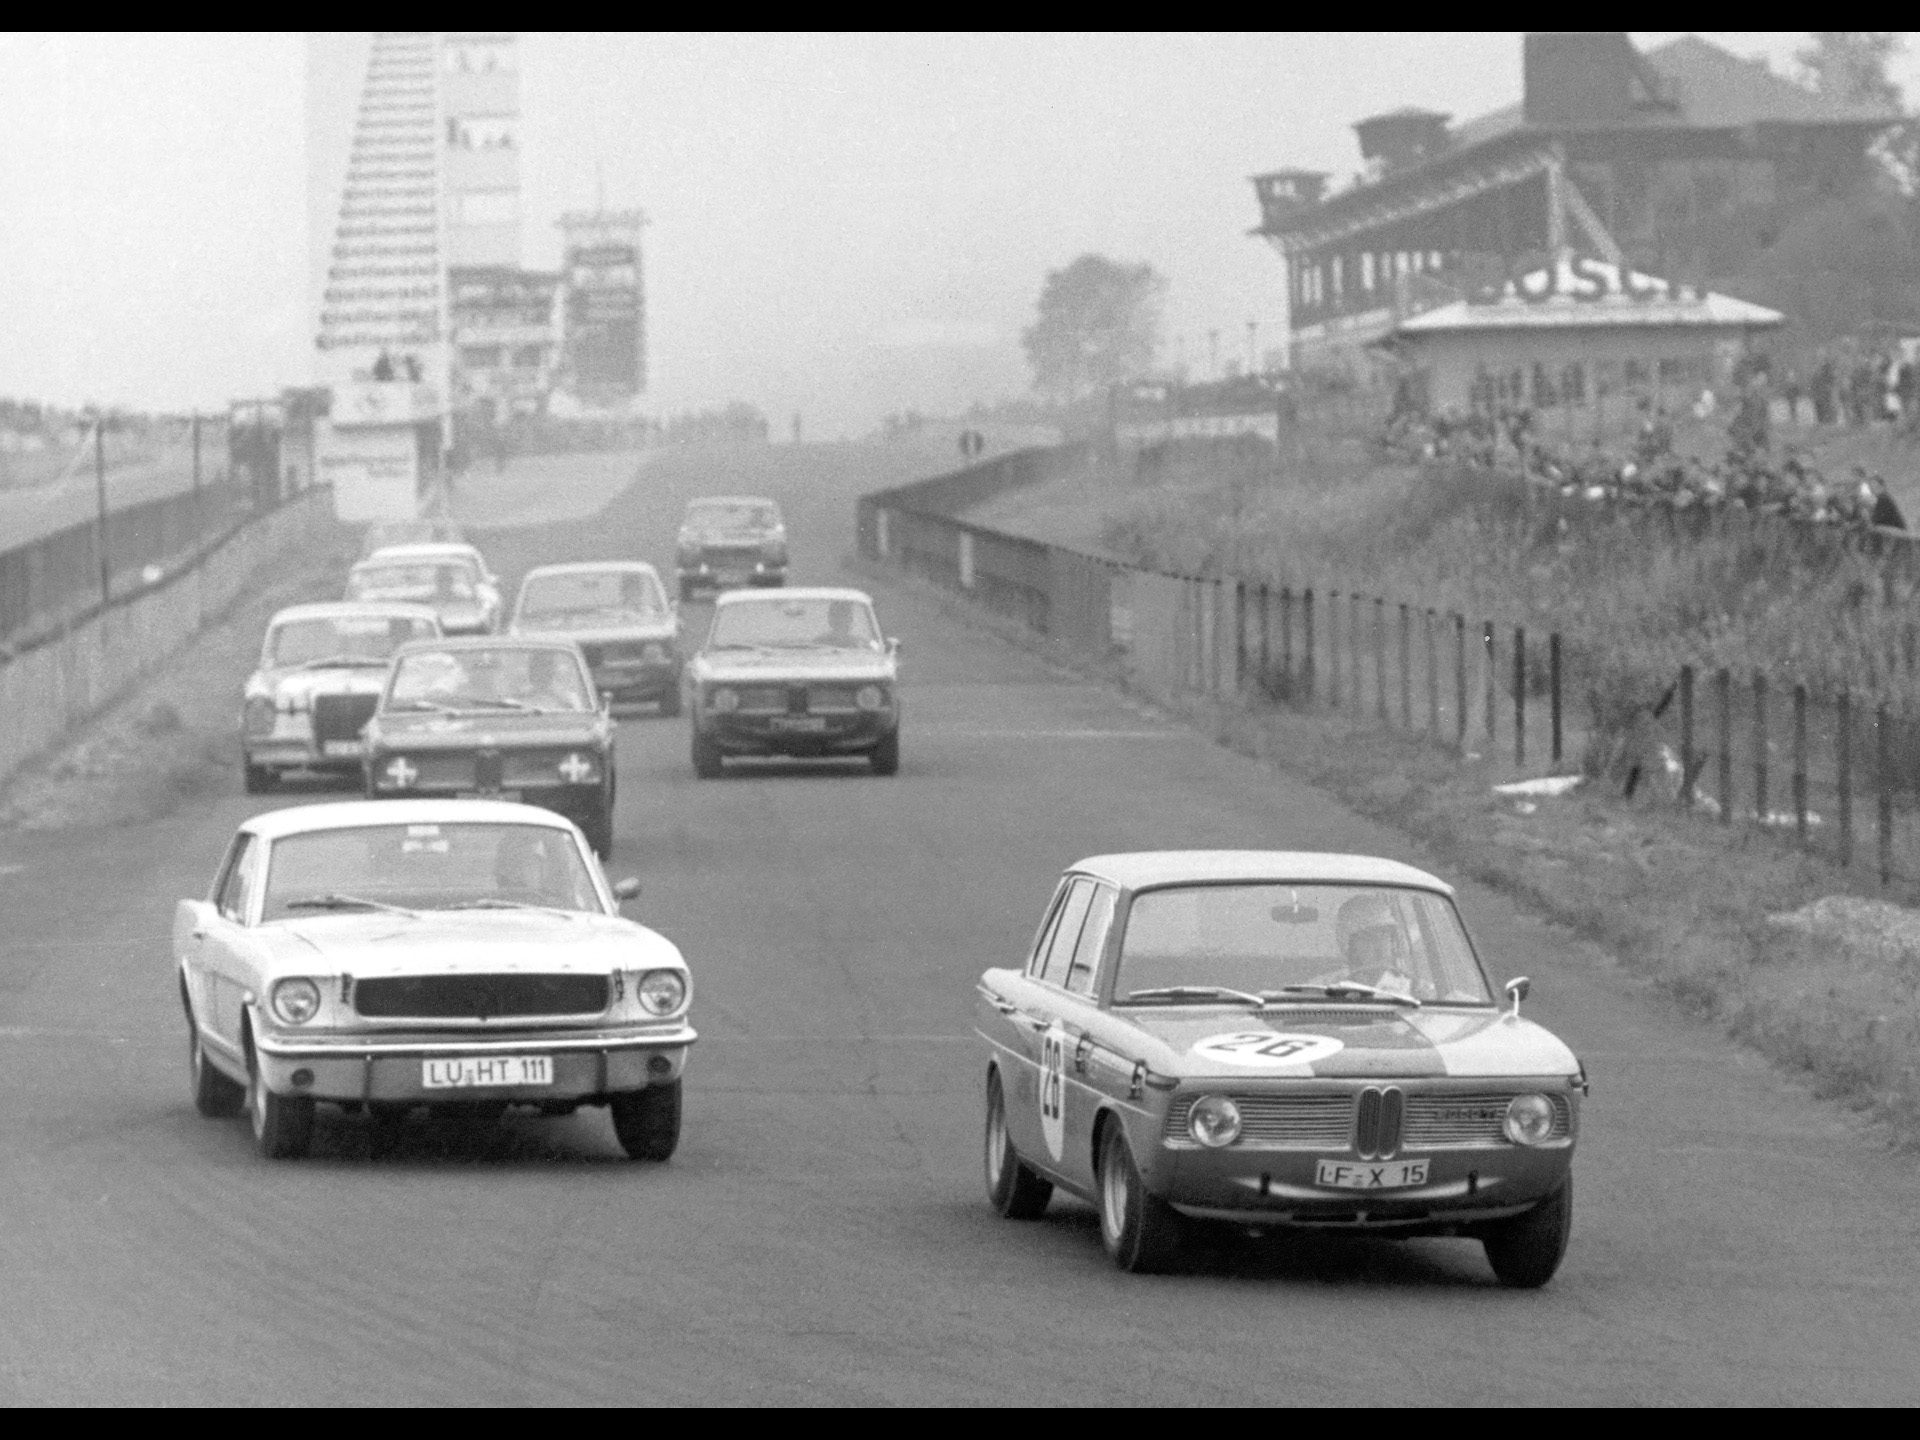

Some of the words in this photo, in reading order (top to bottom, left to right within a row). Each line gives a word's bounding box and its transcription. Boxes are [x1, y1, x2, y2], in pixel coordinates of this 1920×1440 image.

[1207, 1034, 1318, 1058] 26
[521, 1058, 546, 1080] 111
[1401, 1164, 1425, 1184] 15
